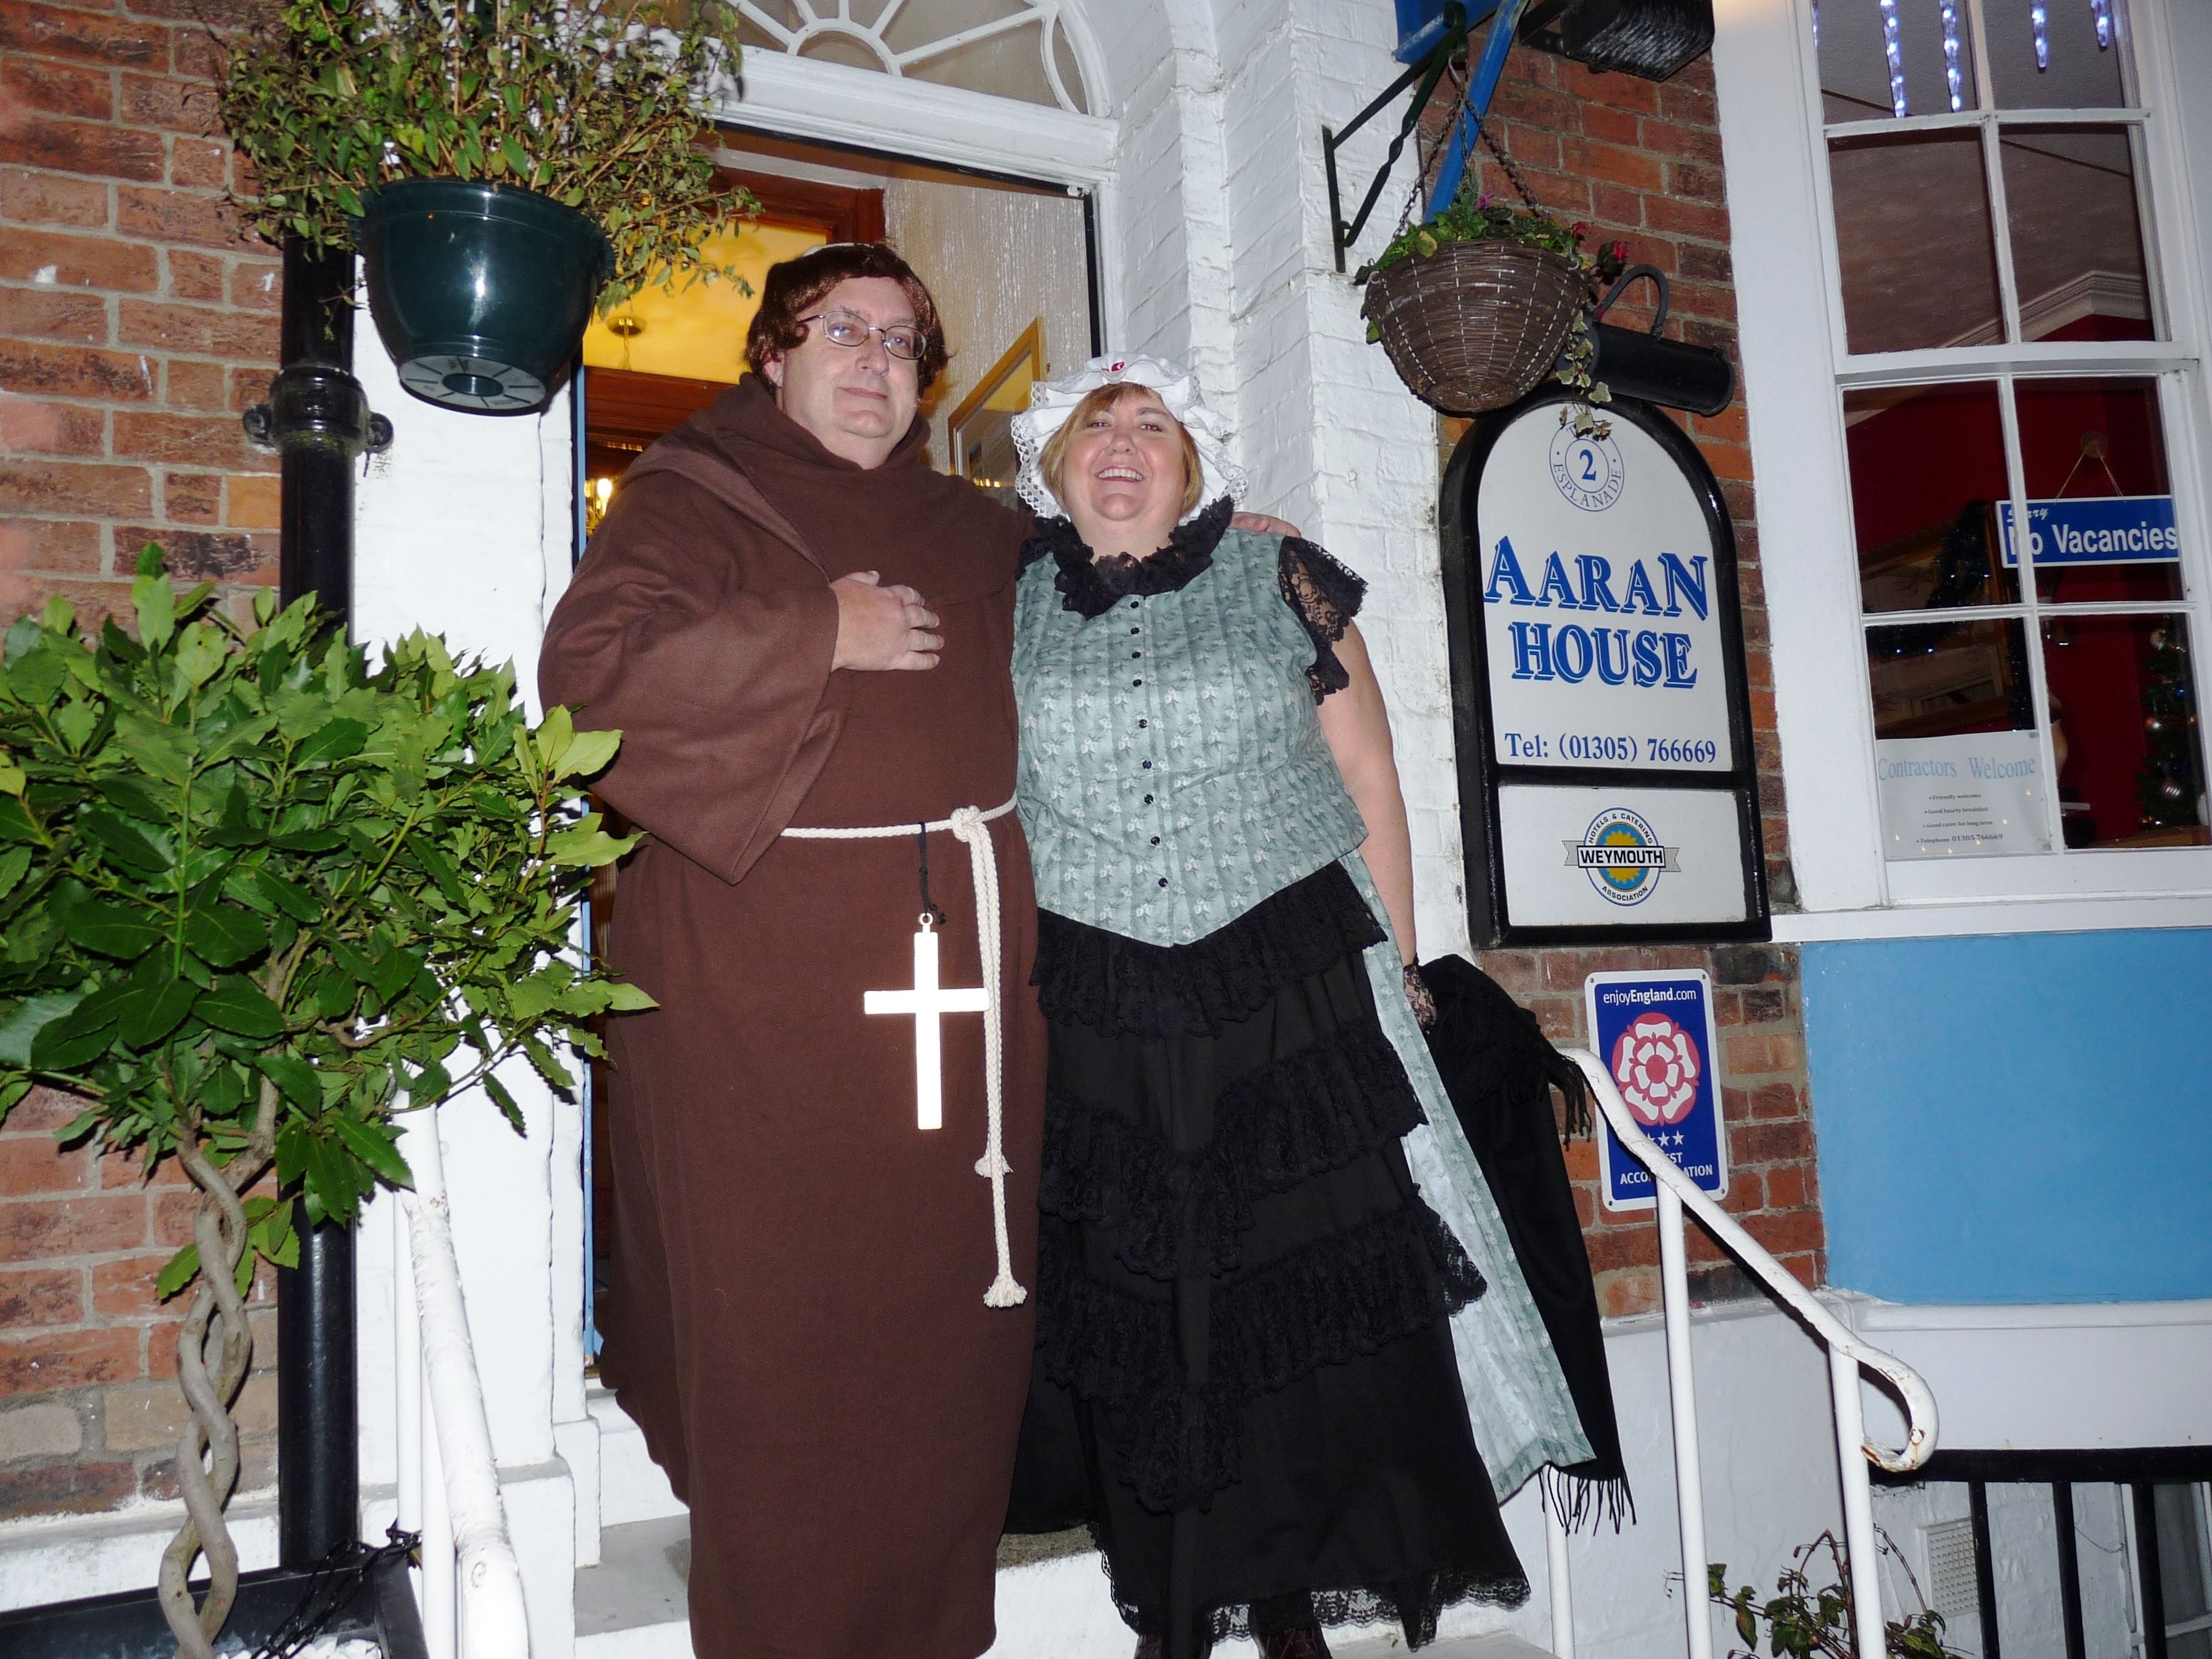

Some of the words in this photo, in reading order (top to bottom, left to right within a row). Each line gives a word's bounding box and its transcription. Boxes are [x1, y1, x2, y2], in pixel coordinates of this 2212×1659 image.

[1580, 449, 1597, 481] 2
[1553, 463, 1621, 508] ESPLANADE
[2051, 521, 2178, 553] Vacancies
[1484, 535, 1708, 621] AARAN
[1508, 622, 1697, 689] HOUSE
[1505, 733, 1548, 757] Tel:
[1559, 733, 1637, 762] (01305)
[1647, 738, 1715, 763] 766669
[1879, 758, 1957, 780] Contractors
[1968, 757, 2036, 779] Welcome
[1589, 817, 1609, 843] HOTELS
[1621, 813, 1653, 844] CATERING
[1580, 850, 1663, 863] WEYMOUTH
[1602, 885, 1648, 901] ASSOCIATION
[1603, 987, 1697, 1006] enjoyEngland.com
[1620, 1165, 1712, 1185] ACCOATION
